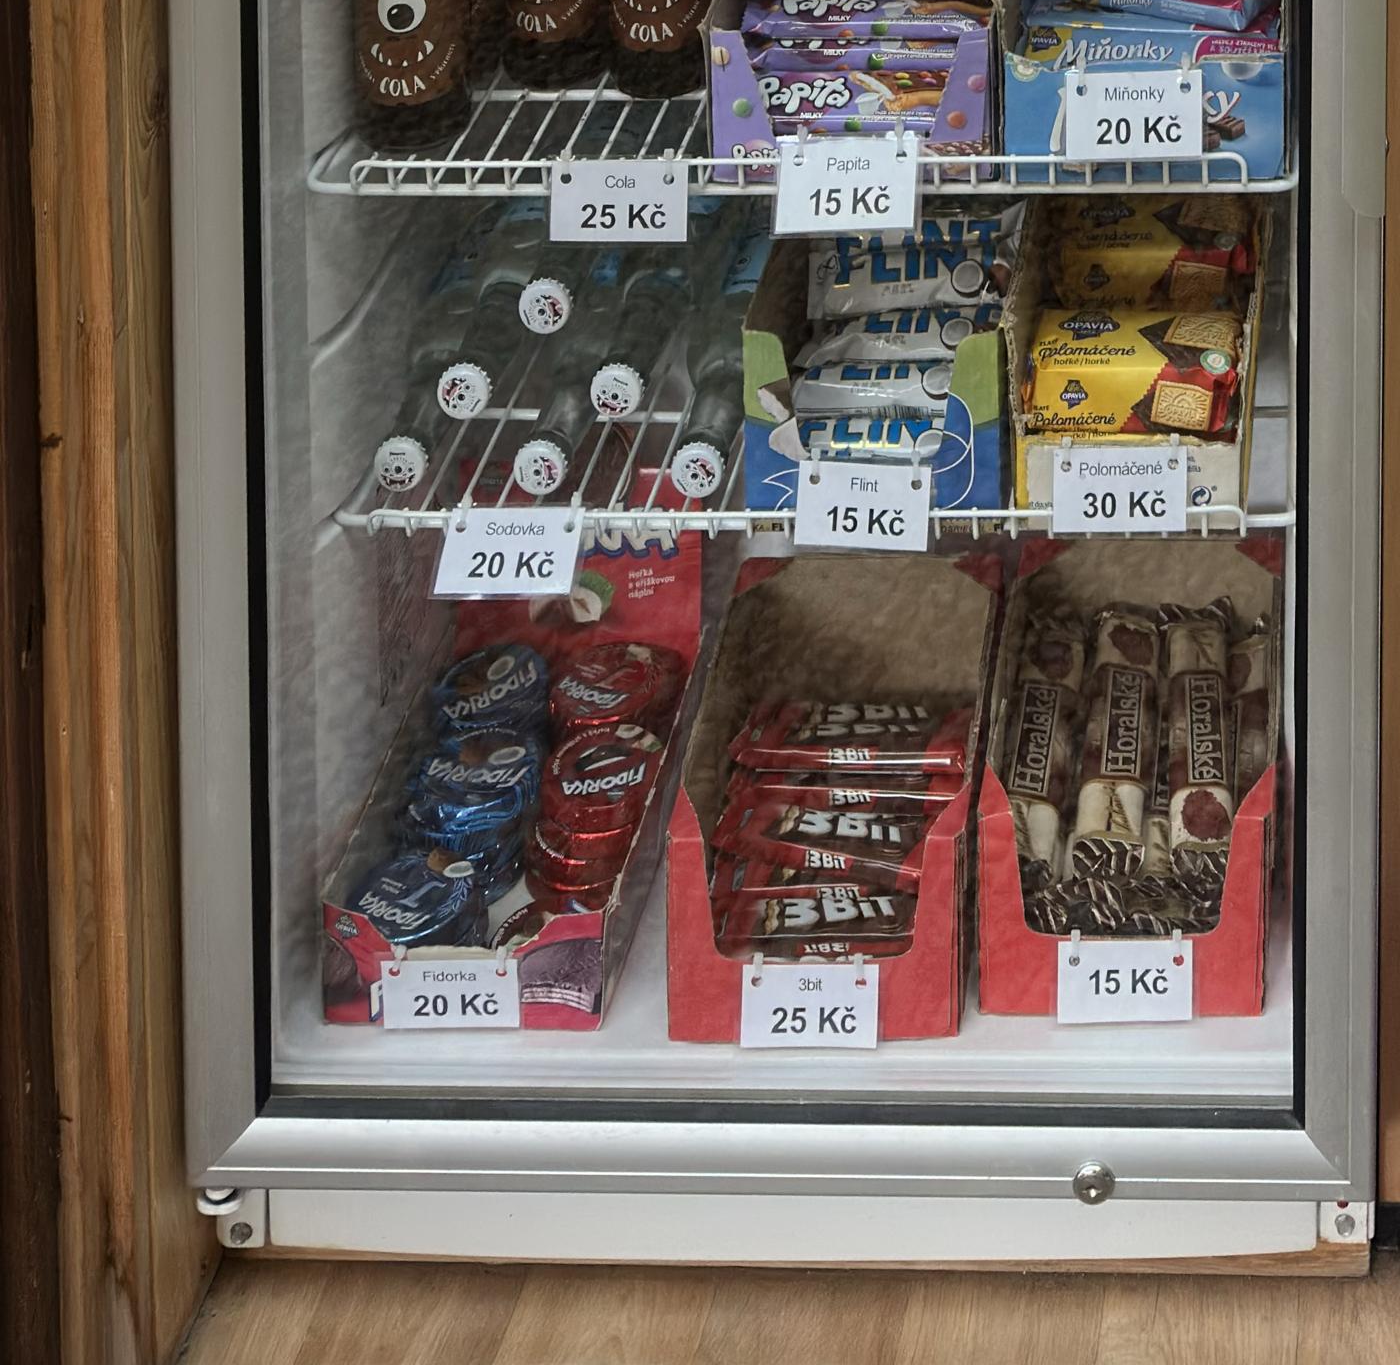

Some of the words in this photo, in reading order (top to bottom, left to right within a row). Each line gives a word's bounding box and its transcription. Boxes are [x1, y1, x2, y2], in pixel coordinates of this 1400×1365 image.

[1057, 38, 1173, 68] Miňonky
[379, 74, 426, 97] COLA
[1105, 86, 1164, 103] Miňonky
[1097, 118, 1131, 144] 20
[1144, 116, 1181, 143] Kč
[827, 157, 870, 174] Papita
[605, 175, 635, 188] Cola
[810, 189, 841, 215] 15
[852, 186, 889, 214] Kč
[581, 204, 615, 229] 25
[629, 204, 665, 228] Kč
[1063, 319, 1113, 331] OPAVIA
[1039, 344, 1135, 359] Polomáčené
[1080, 461, 1162, 476] Polomáčené
[851, 477, 877, 492] Flint
[1083, 493, 1116, 518] 30
[1130, 491, 1166, 517] Kč
[486, 522, 544, 535] Sodovka
[828, 506, 857, 532] 15
[868, 509, 904, 536] Kč
[468, 552, 504, 578] 20
[515, 552, 554, 578] Kč
[1012, 683, 1058, 796] Horalské
[562, 762, 645, 796] FIDORKA
[423, 971, 476, 981] Fidorka
[799, 978, 822, 991] 3bit
[1089, 970, 1120, 994] 15
[1132, 969, 1168, 994] Kč
[414, 995, 448, 1016] 20
[461, 993, 498, 1015] Kč
[771, 1008, 806, 1033] 25
[819, 1007, 856, 1033] Kč
